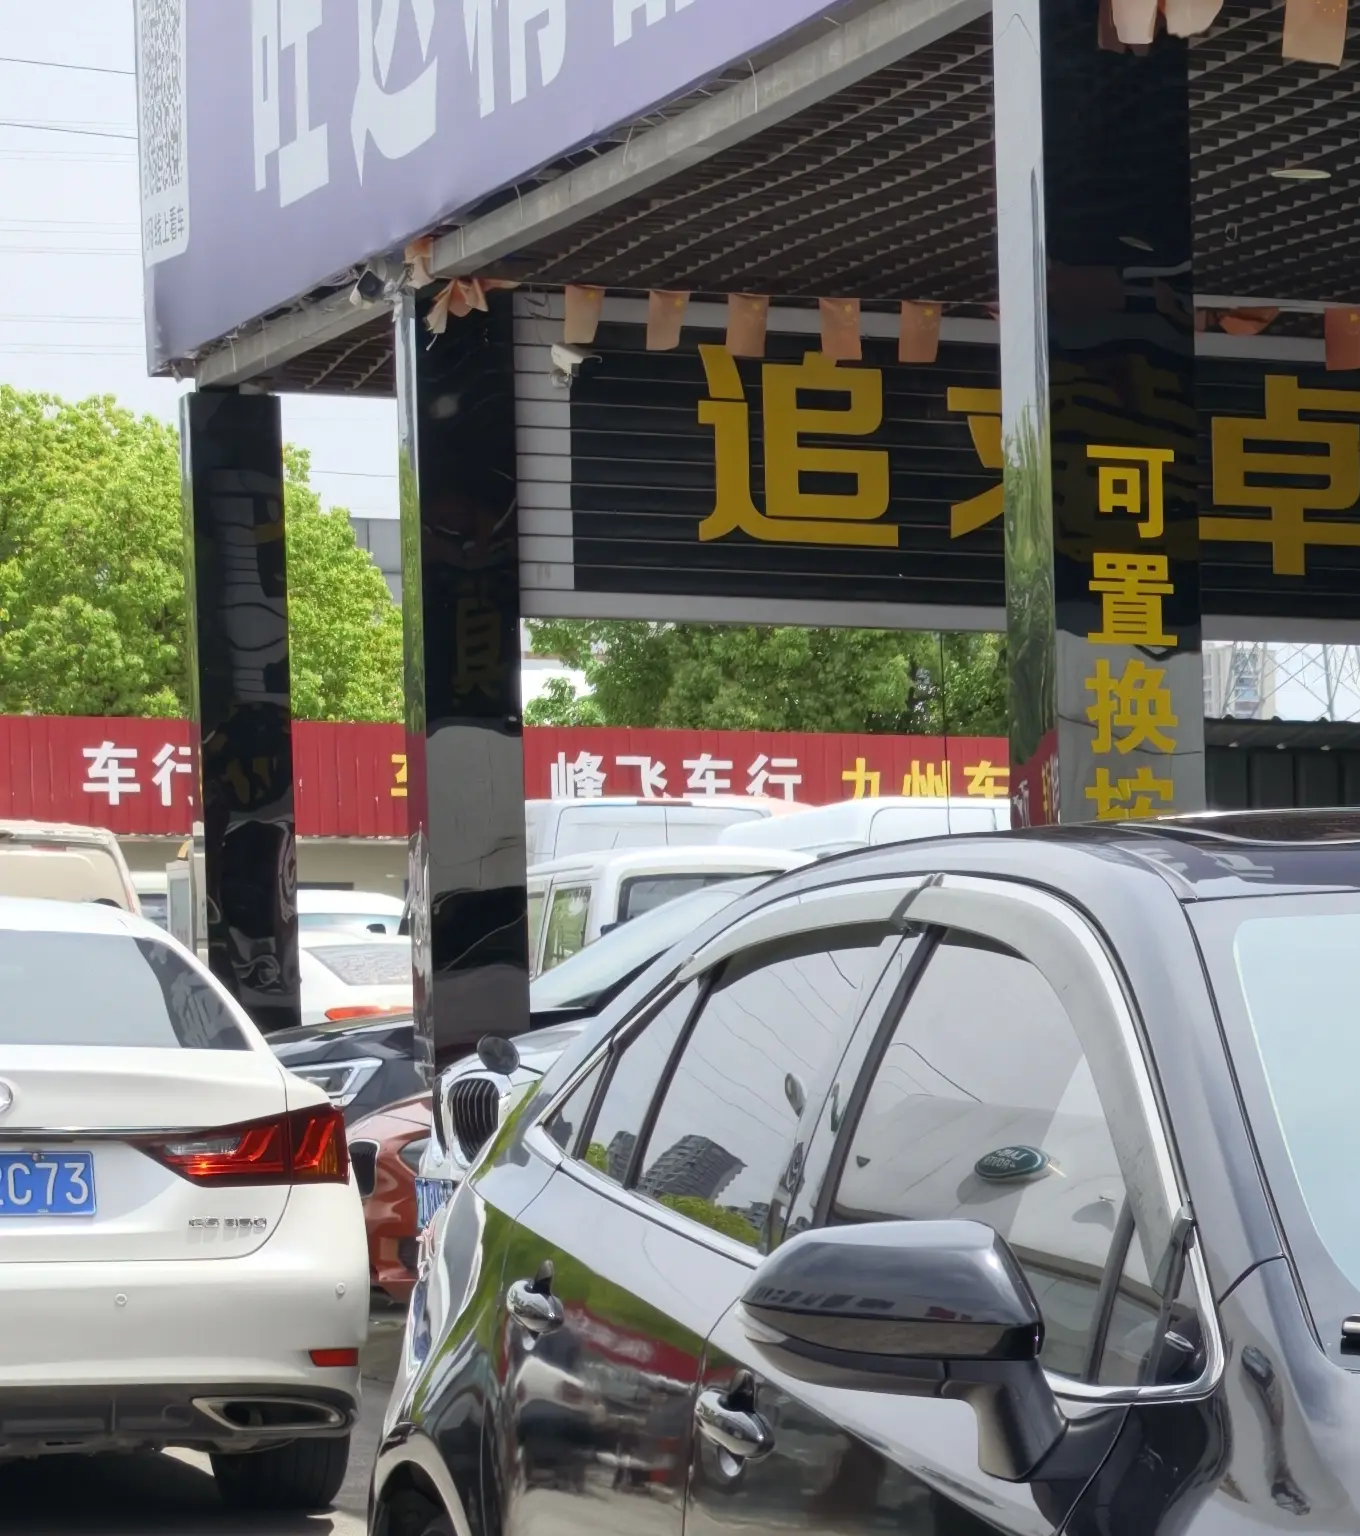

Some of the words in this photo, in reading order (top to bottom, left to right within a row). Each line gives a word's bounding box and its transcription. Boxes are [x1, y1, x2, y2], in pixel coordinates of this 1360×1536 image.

[550, 751, 802, 801] 峰飞车行
[0, 1162, 89, 1207] C73
